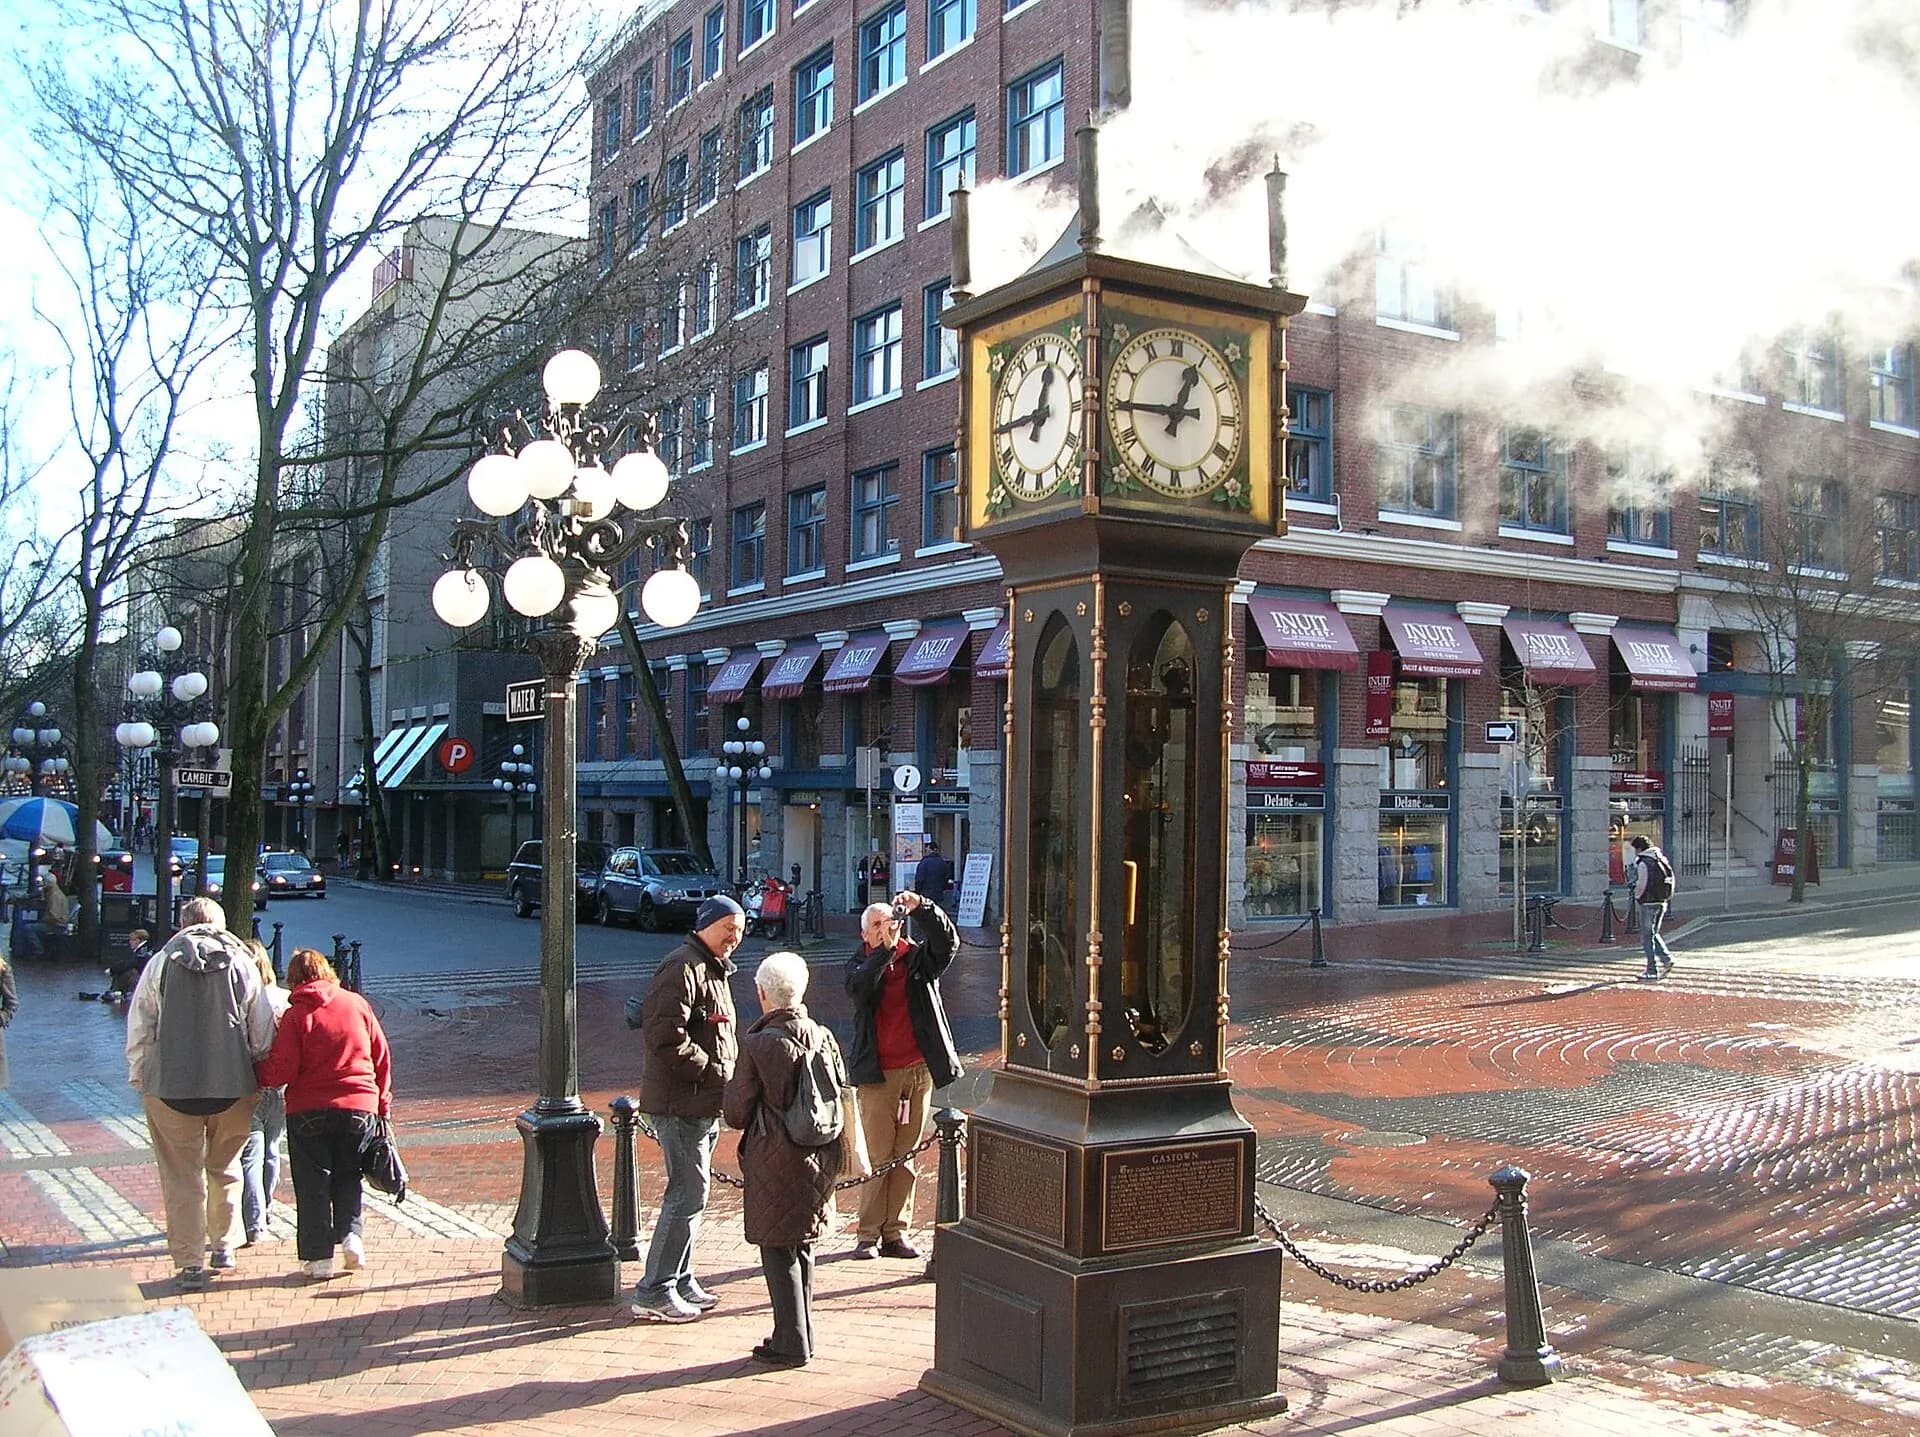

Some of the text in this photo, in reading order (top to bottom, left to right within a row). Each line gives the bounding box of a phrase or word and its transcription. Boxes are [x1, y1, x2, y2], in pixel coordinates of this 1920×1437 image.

[1214, 382, 1228, 393] II
[1071, 400, 1081, 412] III
[1221, 415, 1235, 427] III
[1269, 611, 1330, 631] INUIT
[1402, 622, 1456, 642] INUIT
[1521, 632, 1570, 651] INUIT
[1628, 642, 1673, 658] INUIT
[1368, 675, 1391, 686] INUIT
[511, 688, 536, 714] WATER
[448, 744, 467, 767] P
[1270, 763, 1299, 771] Entrance
[181, 771, 214, 785] CAMBIE
[1264, 793, 1294, 807] Delané
[1394, 795, 1422, 808] Delané
[1151, 1151, 1199, 1164] GASTOWN
